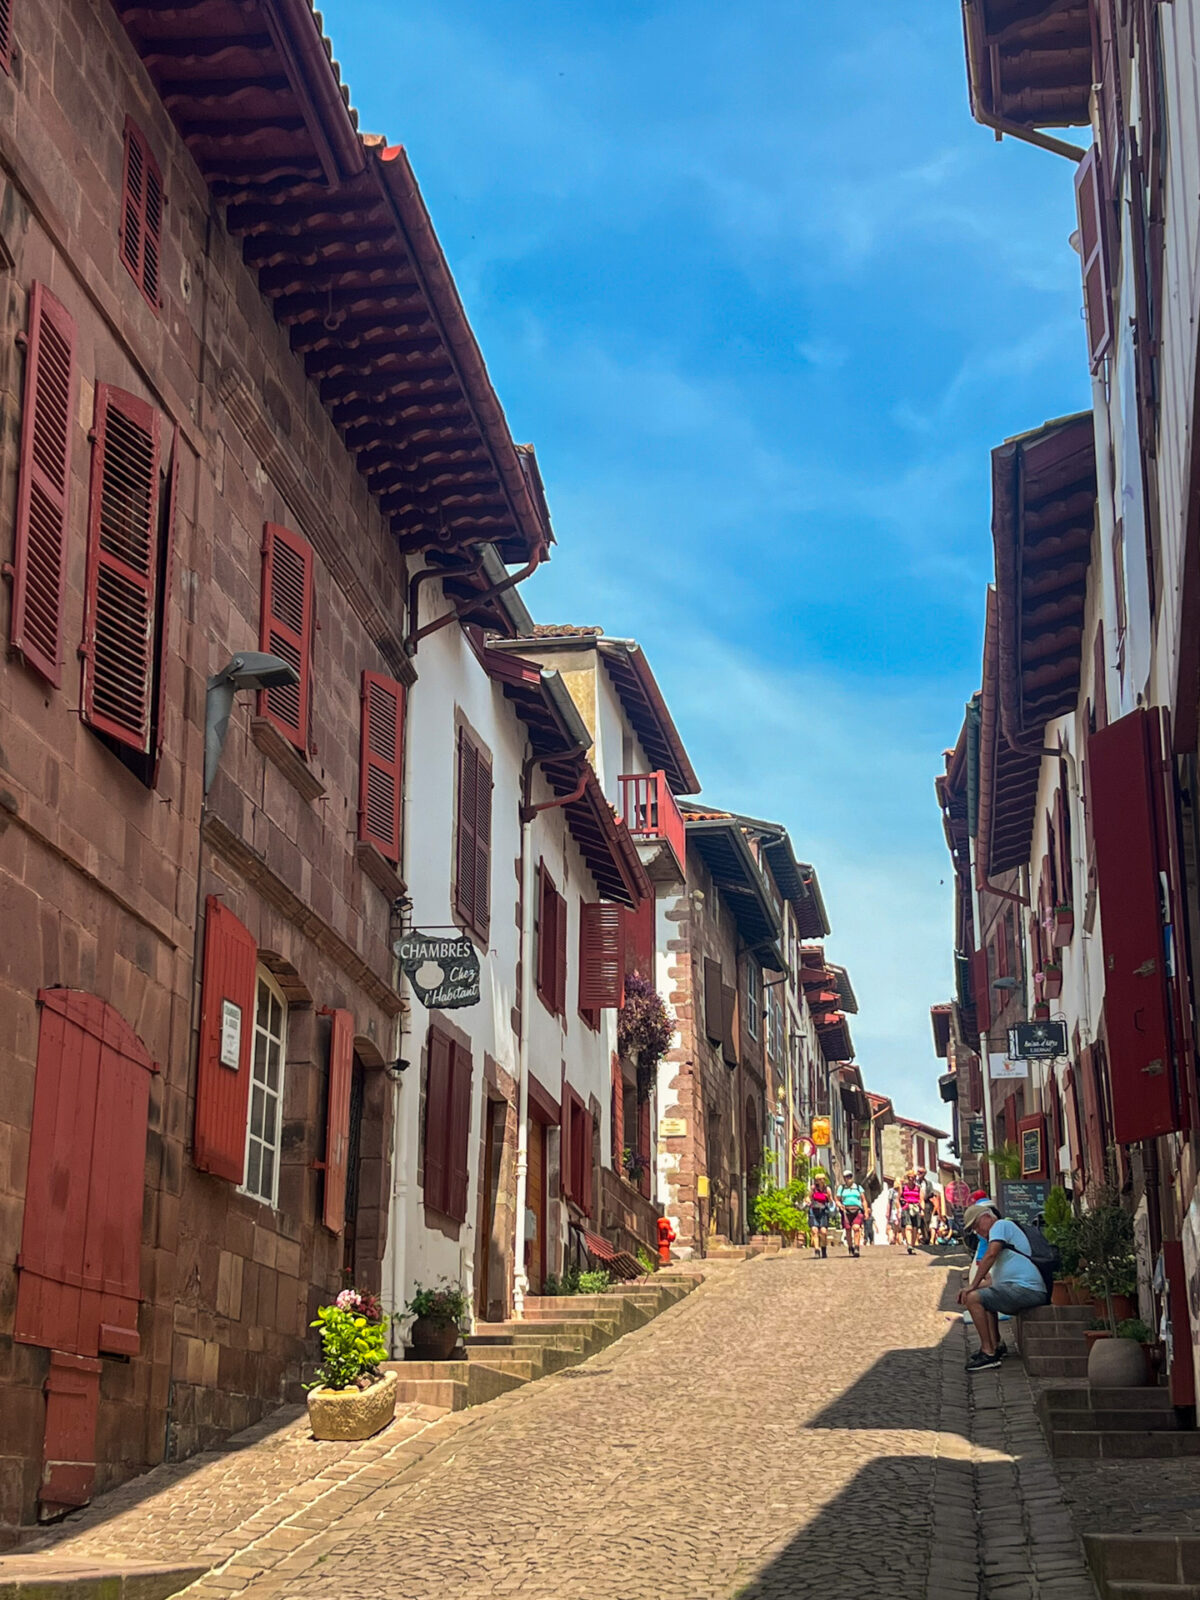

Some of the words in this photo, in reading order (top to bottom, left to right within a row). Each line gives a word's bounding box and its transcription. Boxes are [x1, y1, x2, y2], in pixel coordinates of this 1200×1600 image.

[401, 942, 471, 959] CHAMBRES
[450, 967, 477, 983] Chez
[424, 984, 478, 1006] l'Habitant
